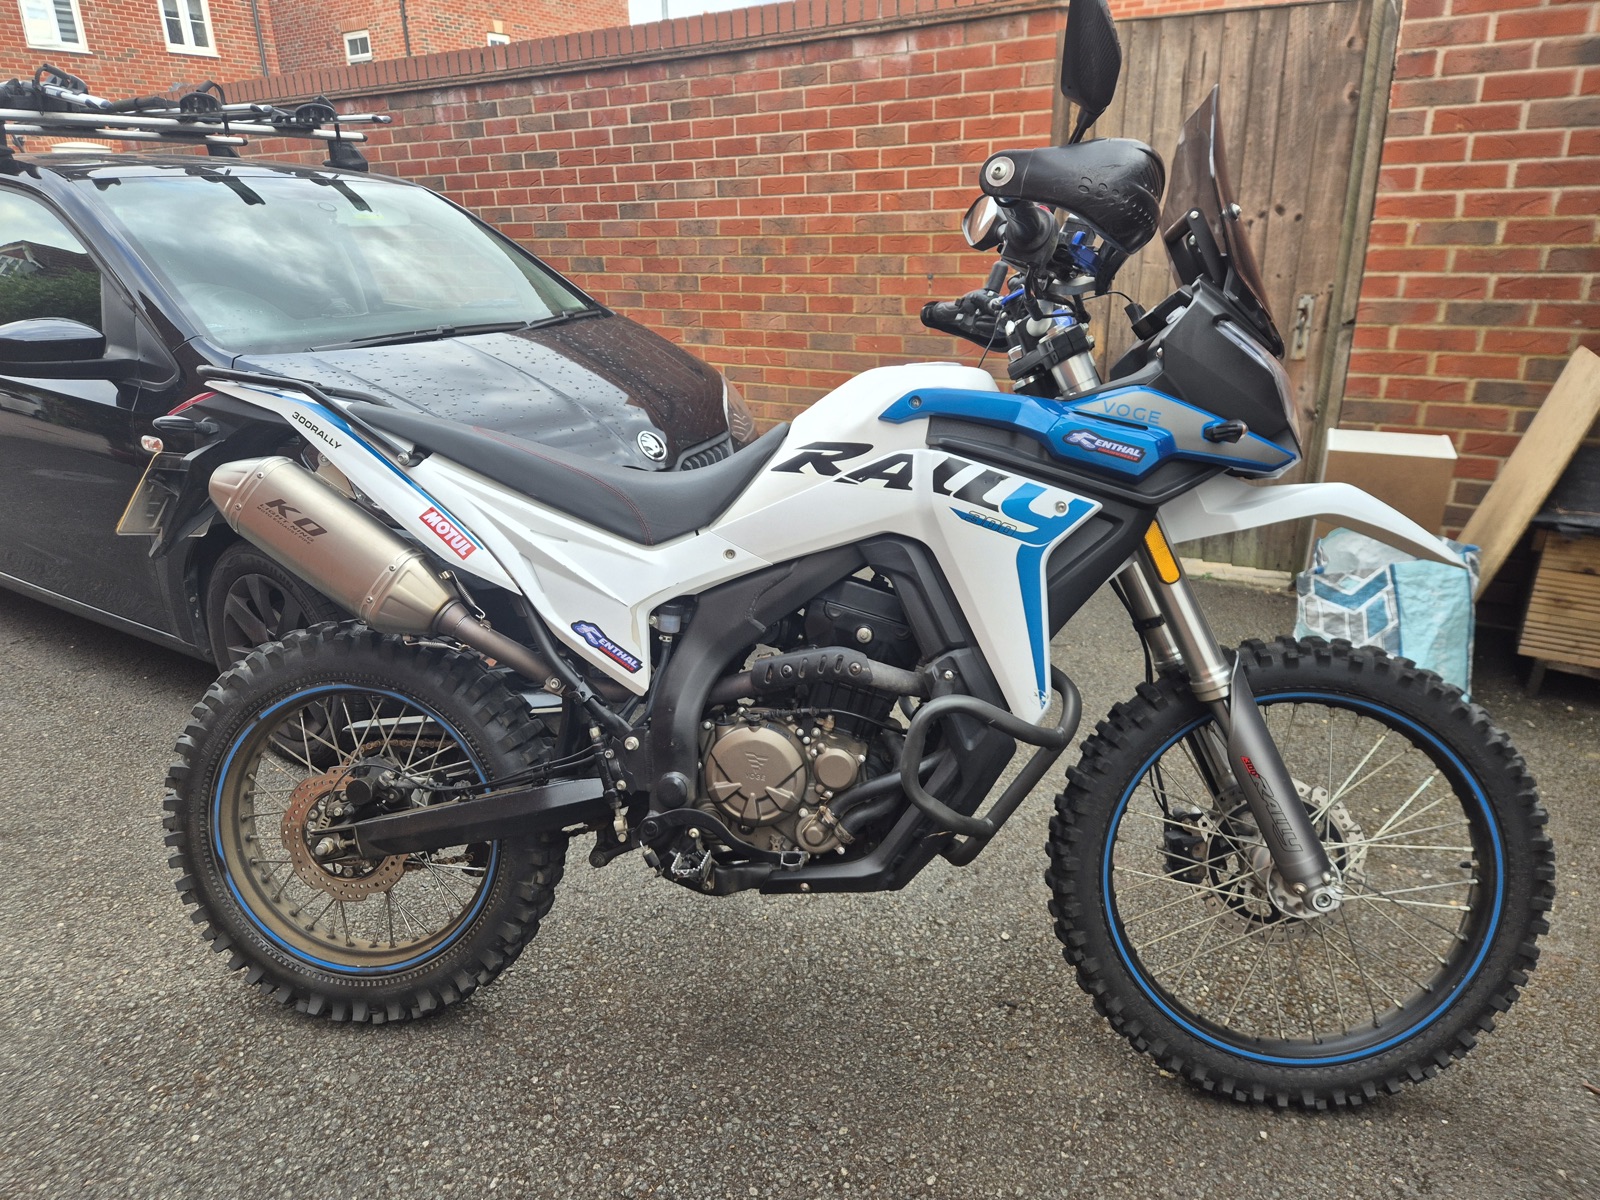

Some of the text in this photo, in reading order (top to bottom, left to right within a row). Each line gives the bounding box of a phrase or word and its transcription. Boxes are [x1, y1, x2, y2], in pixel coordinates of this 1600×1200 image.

[1103, 400, 1162, 424] VOGE
[291, 411, 342, 449] 300RALLY
[422, 511, 472, 556] MOTUL
[964, 509, 1018, 537] 300
